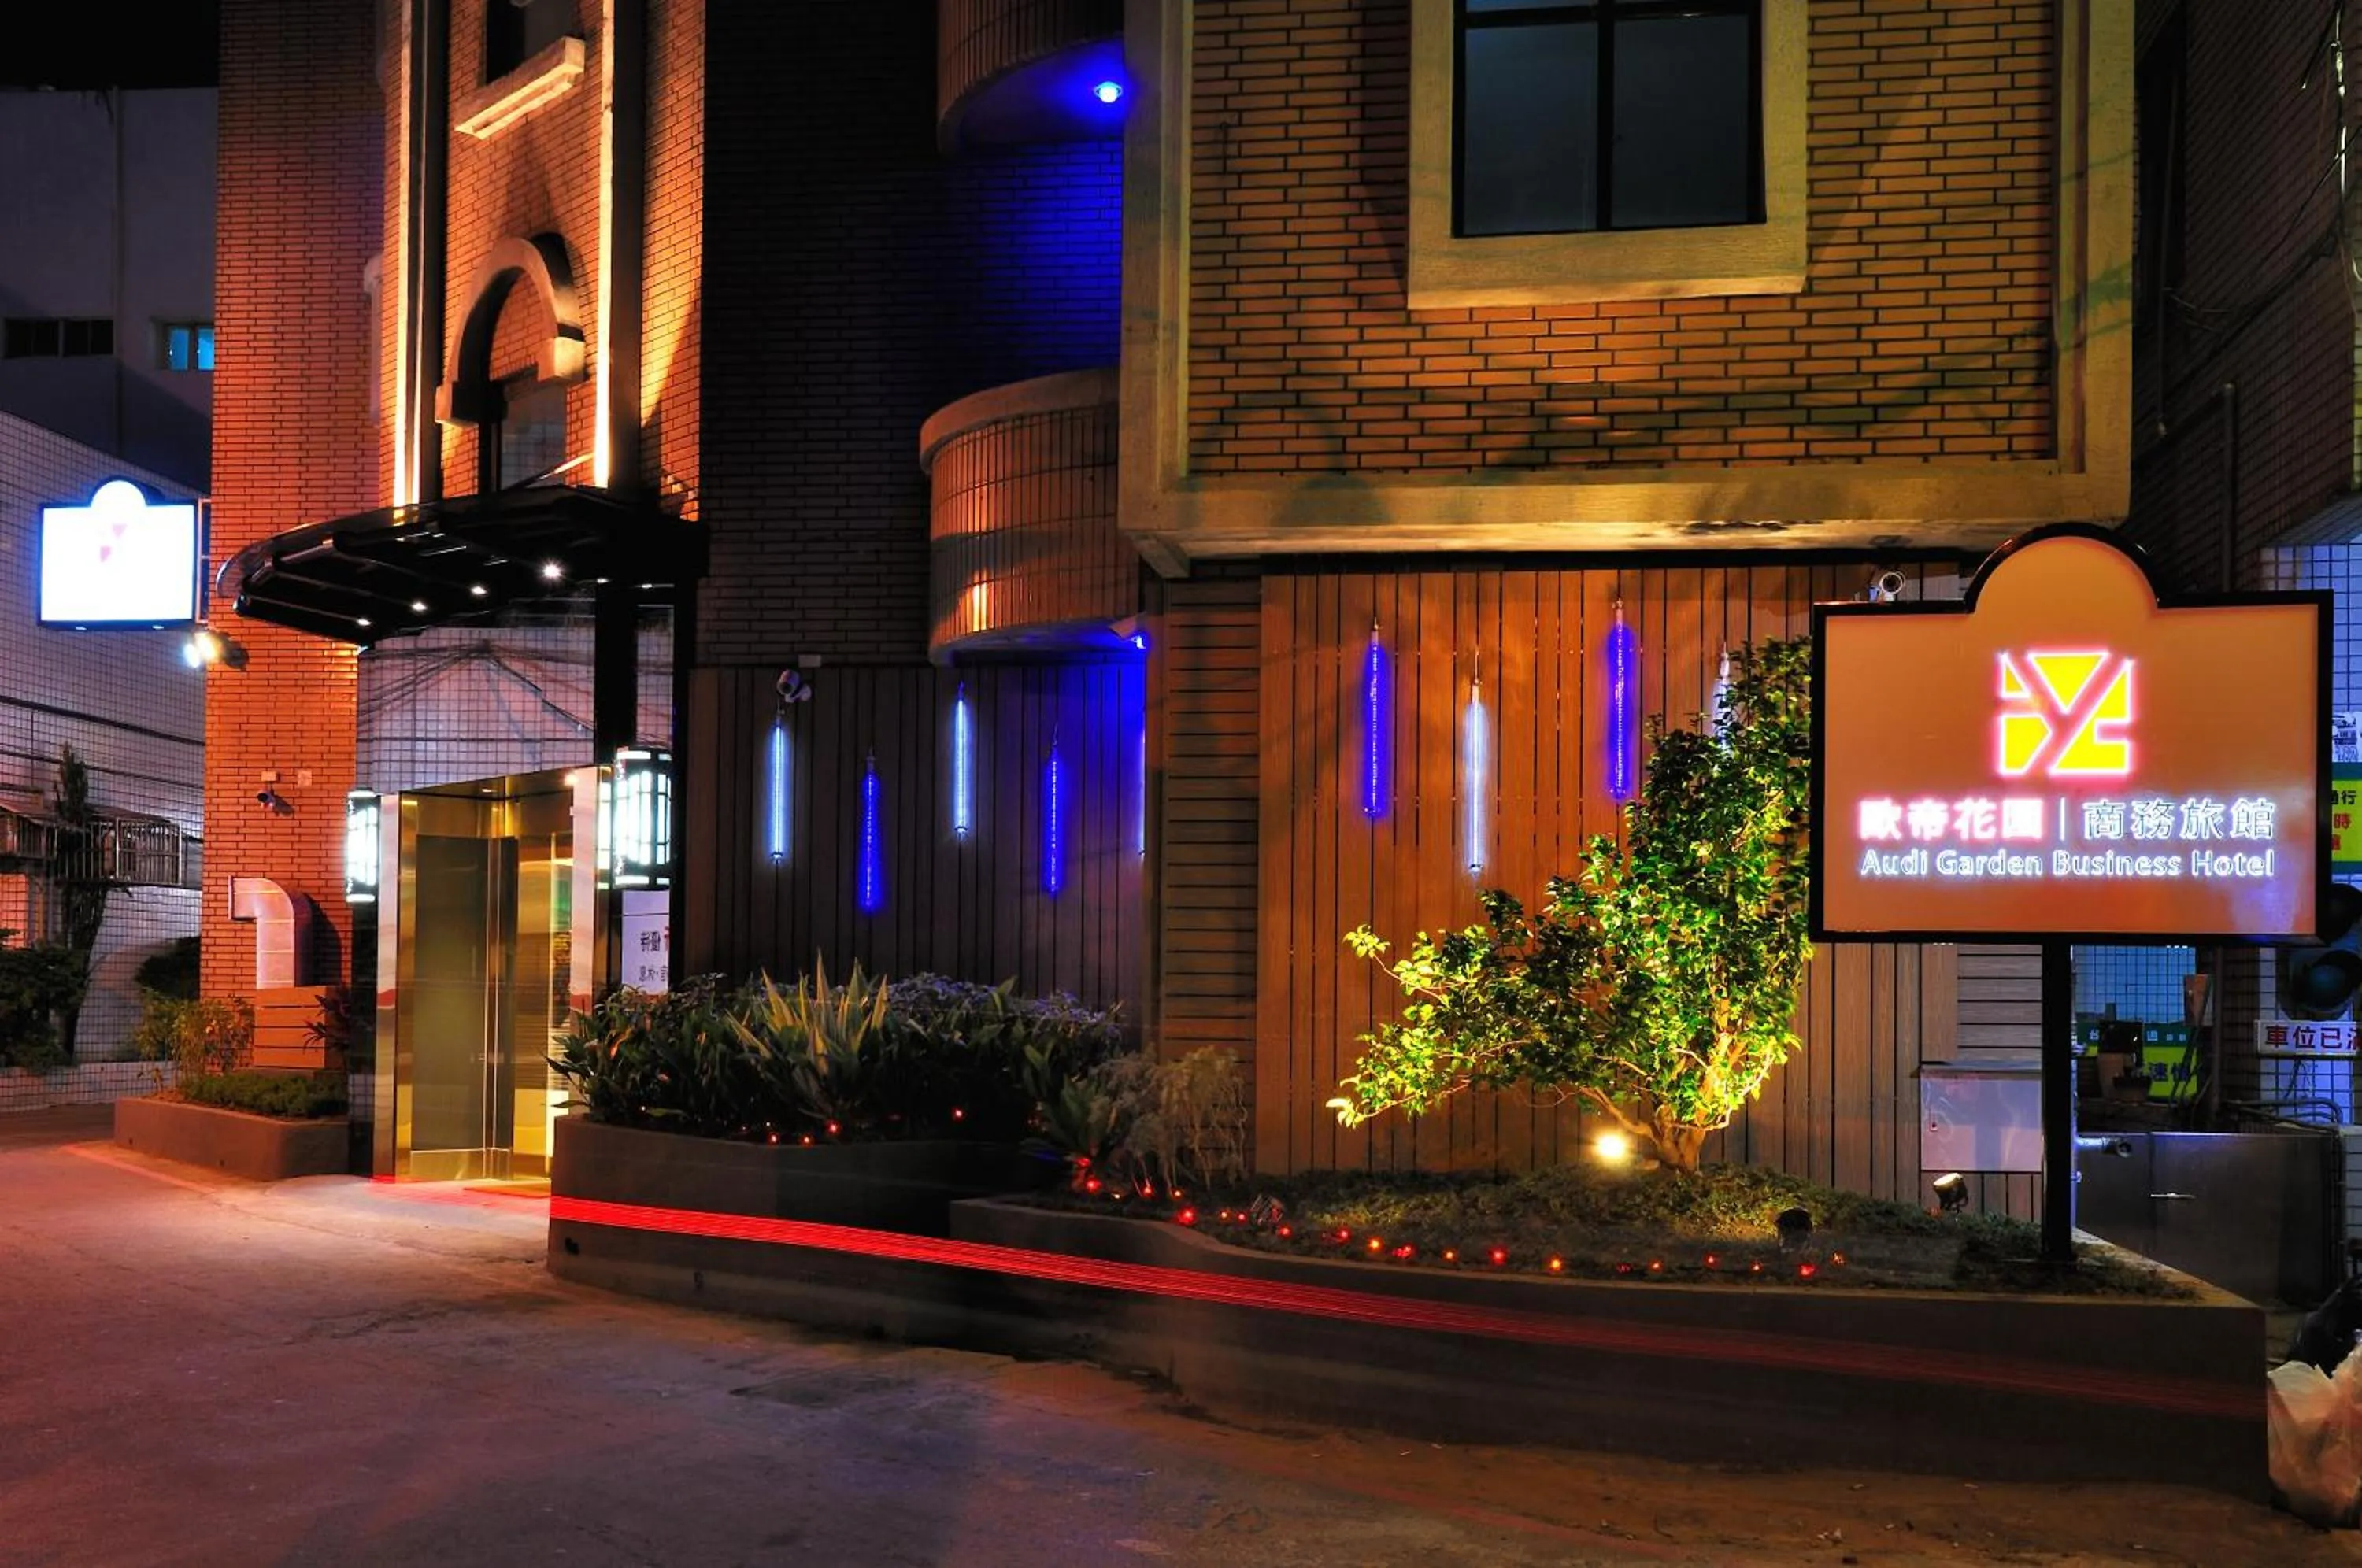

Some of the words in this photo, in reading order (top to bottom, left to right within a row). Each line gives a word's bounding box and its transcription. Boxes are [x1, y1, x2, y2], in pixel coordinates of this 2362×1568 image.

[2082, 797, 2275, 840] 商務旅館
[1860, 849, 1928, 875] Audi
[1936, 849, 2043, 875] Garden
[2053, 849, 2182, 876] Business
[2191, 849, 2275, 876] Hotel
